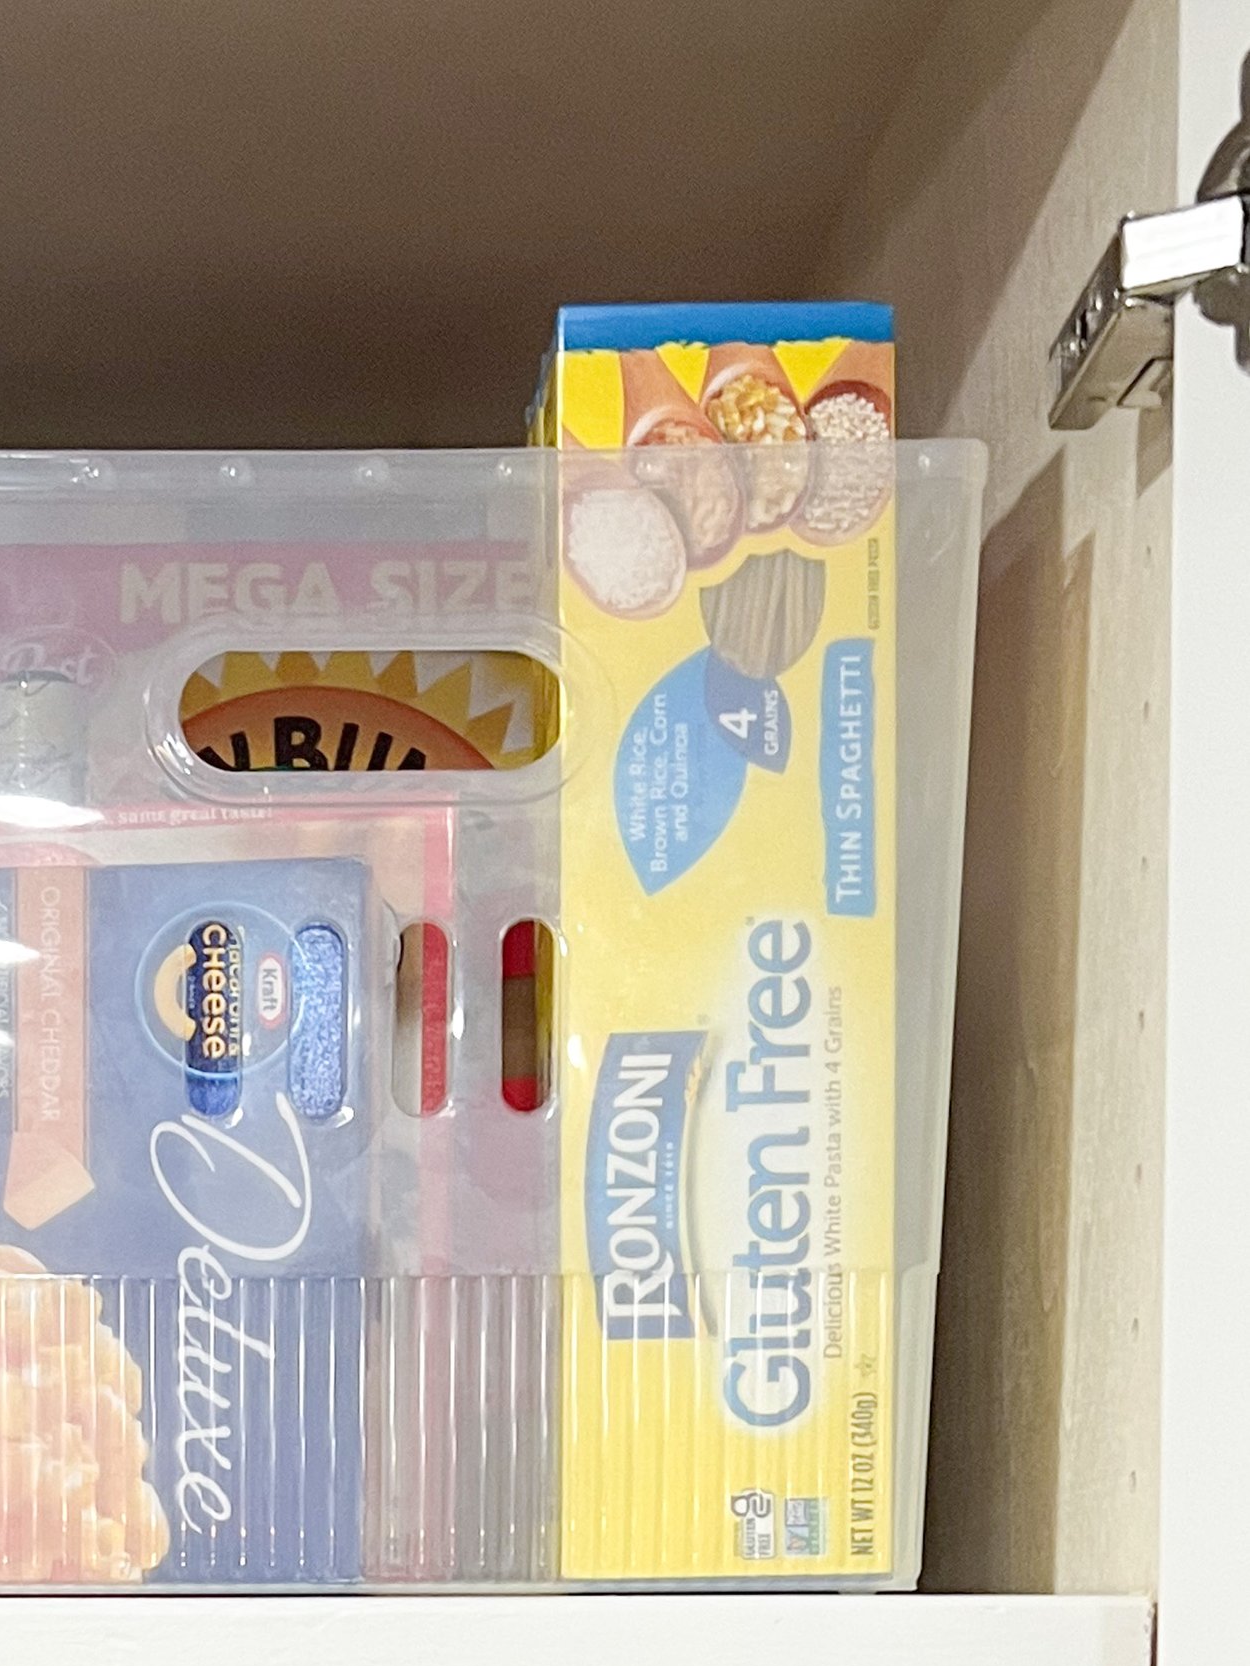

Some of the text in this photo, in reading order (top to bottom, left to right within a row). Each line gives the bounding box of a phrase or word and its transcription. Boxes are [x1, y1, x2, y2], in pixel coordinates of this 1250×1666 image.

[120, 561, 536, 626] MEGA SIZE
[650, 693, 667, 746] Corn
[718, 708, 758, 739] 4
[763, 690, 779, 756] GRAINS
[629, 782, 647, 842] White
[671, 723, 688, 842] and Quinoa
[836, 654, 862, 904] THIN SPAGHETTI
[650, 804, 668, 872] Brown
[40, 886, 62, 1121] ORIGINAL CHEDDAR
[262, 968, 277, 1011] Kraft
[823, 985, 842, 1054] Grains
[824, 1079, 842, 1131] with
[606, 1052, 674, 1319] RONZONI
[722, 919, 812, 1428] Gluten Free
[824, 1134, 842, 1188] Pasta
[824, 1195, 842, 1257] White
[150, 1092, 311, 1534] Deluxe
[823, 1262, 843, 1361] Delicious
[851, 1391, 878, 1556] NET WT 12 OZ (340g)
